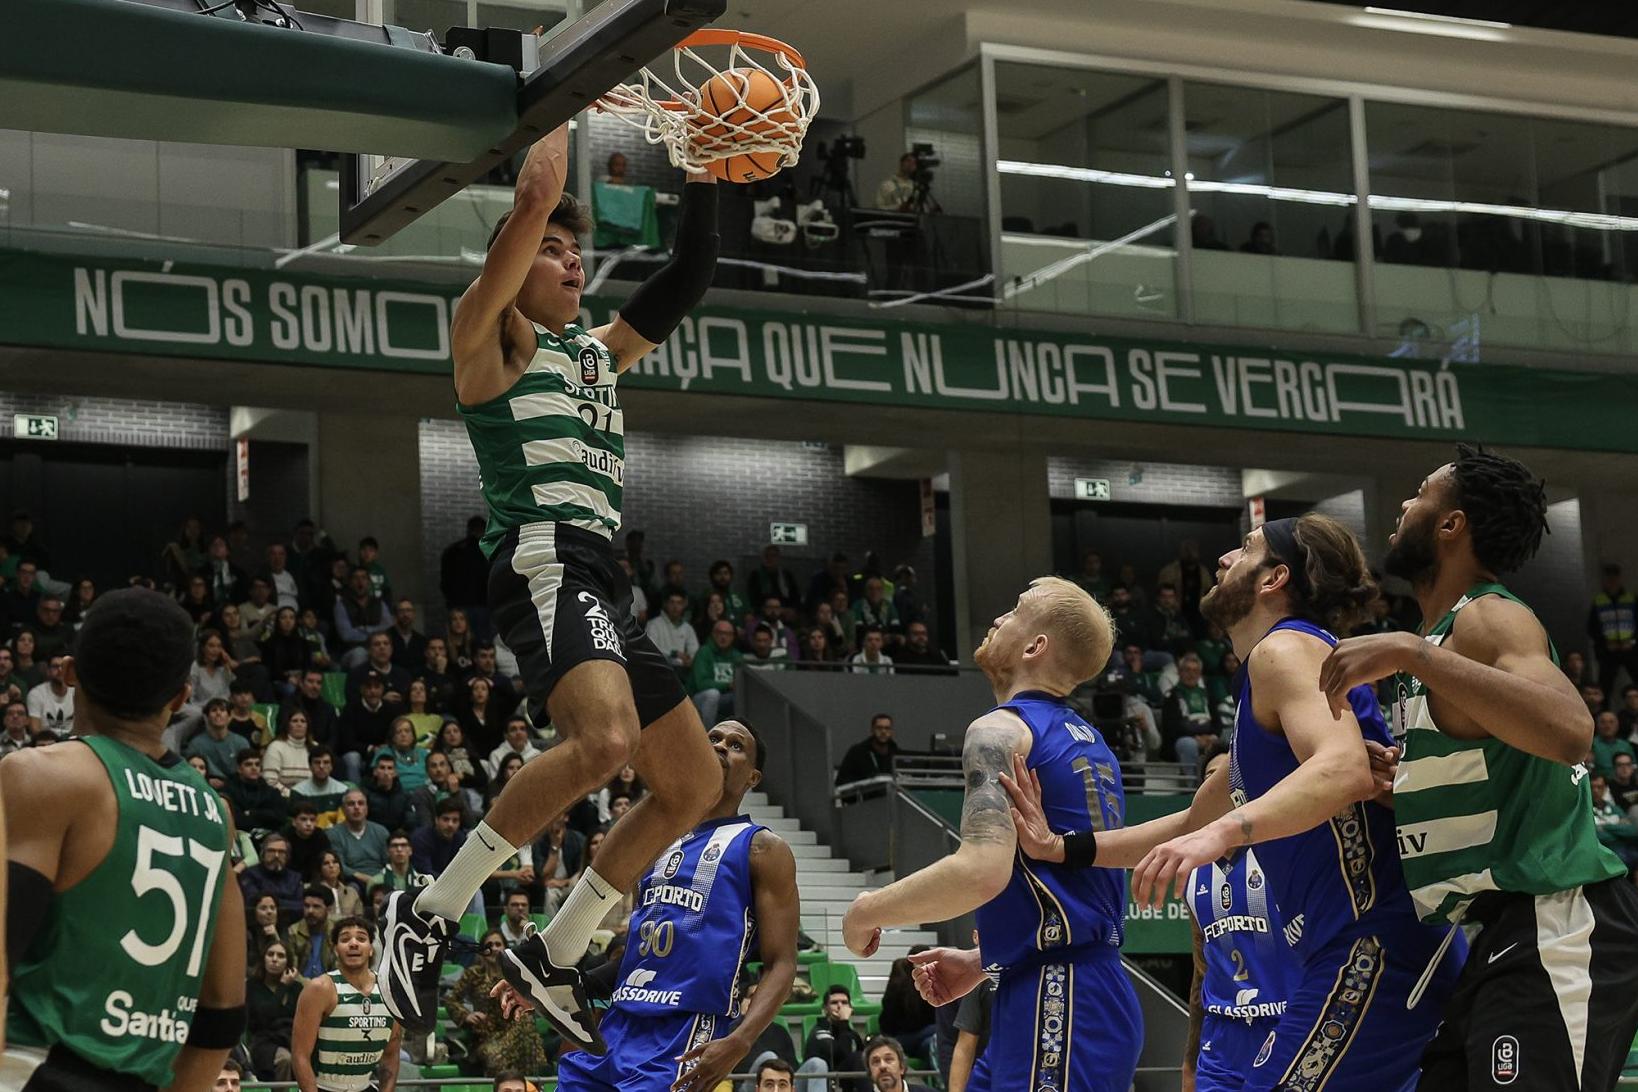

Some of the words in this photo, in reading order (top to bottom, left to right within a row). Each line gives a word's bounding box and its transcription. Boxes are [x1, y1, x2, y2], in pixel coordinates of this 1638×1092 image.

[74, 260, 254, 346] NÓS
[608, 311, 752, 390] AÇA
[763, 322, 892, 392] QUE
[900, 332, 1120, 408] NUNCA
[1128, 349, 1206, 413] SE
[1212, 355, 1465, 430] VERGARÁ
[124, 768, 199, 817] LOVETT
[120, 825, 226, 977] 57
[639, 920, 675, 958] 90
[1231, 949, 1249, 982] 2
[349, 1017, 386, 1028] SPORTING
